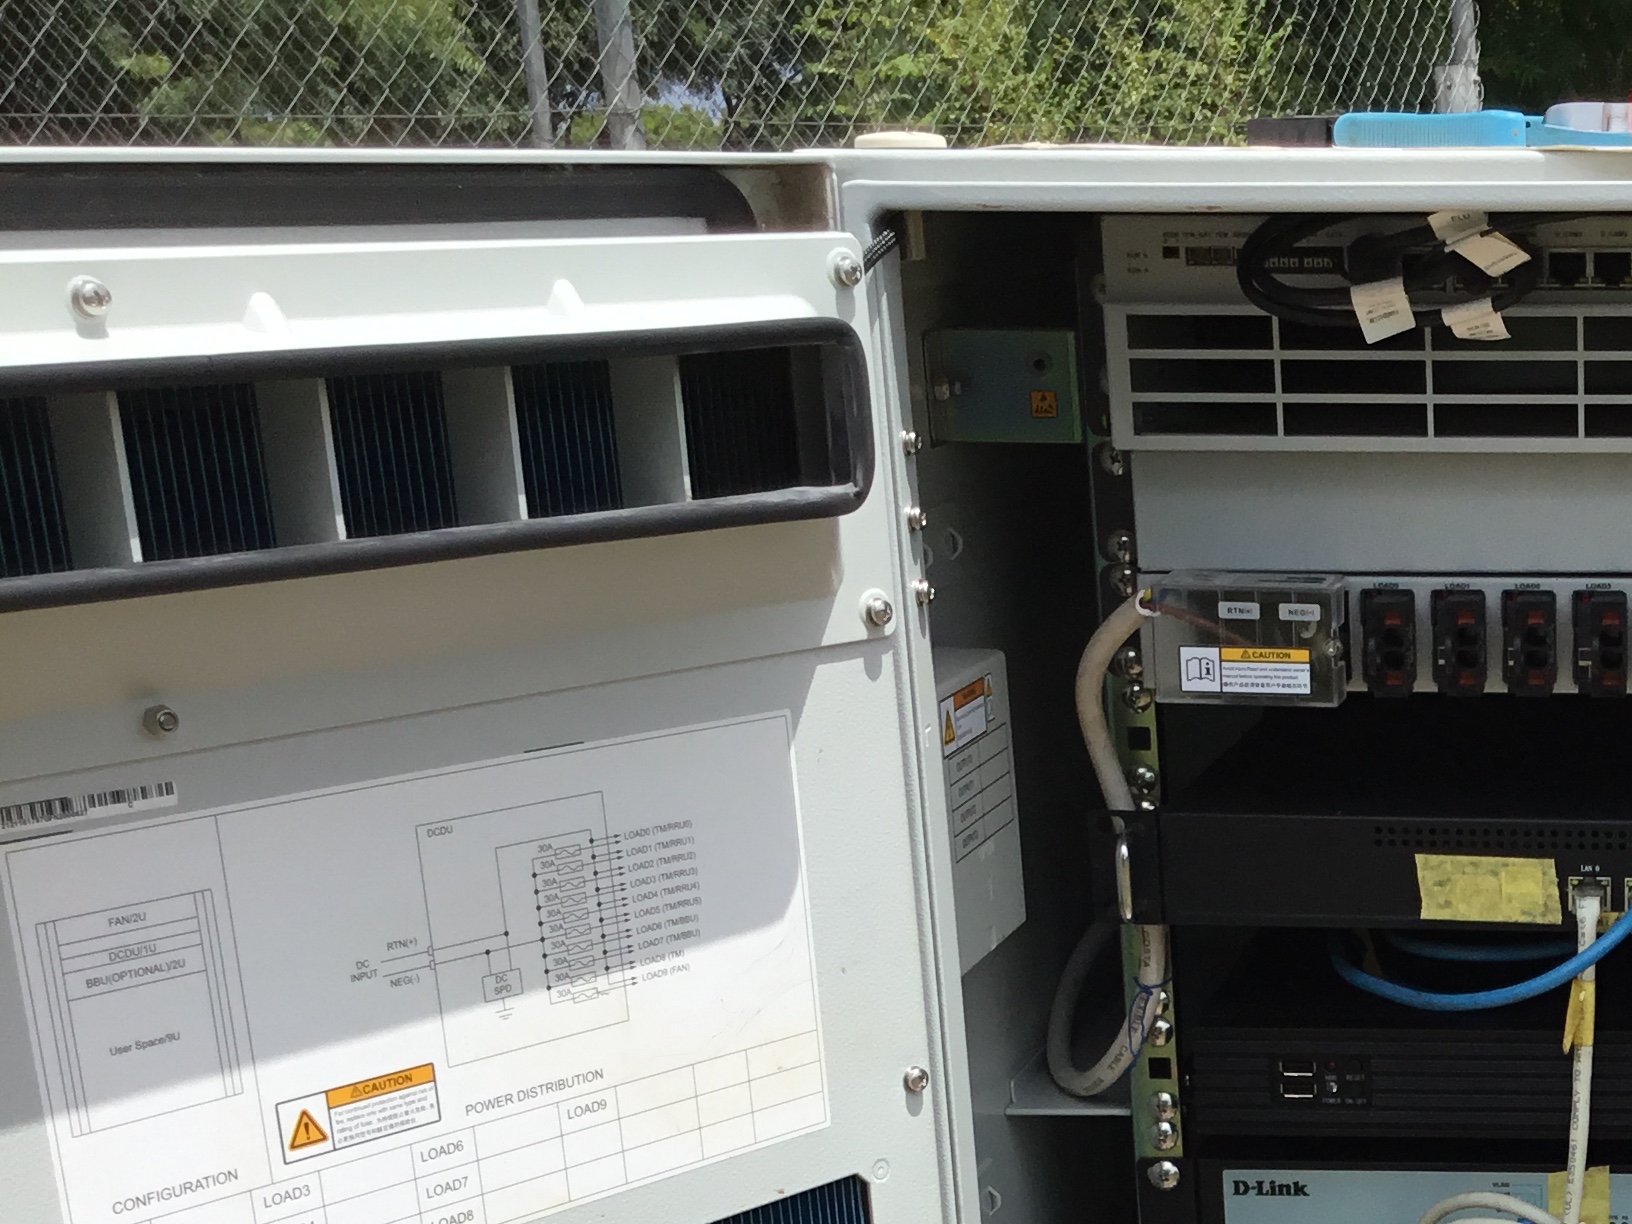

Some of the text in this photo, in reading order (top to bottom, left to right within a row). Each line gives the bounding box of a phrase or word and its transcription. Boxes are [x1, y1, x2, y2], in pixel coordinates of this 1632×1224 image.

[1252, 651, 1291, 660] CAUTION
[426, 826, 454, 838] DCDU
[1580, 864, 1593, 872] LAN
[108, 911, 147, 928] FAN/2U
[108, 943, 157, 962] DCDU/1U
[387, 937, 418, 951] RTN(+)
[86, 958, 187, 989] BBU(OPTIONAL)/2U
[356, 959, 370, 970] DC
[350, 969, 378, 983] INPUT
[390, 974, 420, 988] NEG(-)
[495, 974, 508, 984] DC
[494, 985, 512, 995] SPD
[109, 1031, 181, 1057] User Space/9U
[1106, 1045, 1128, 1072] CABLE
[362, 1074, 413, 1095] CAUTION
[465, 1091, 514, 1117] POWER
[517, 1069, 605, 1103] DISTRIBUTION
[566, 1099, 608, 1120] LOAD9
[420, 1140, 464, 1163] LOAD6
[112, 1168, 239, 1215] CONFIGURATION
[263, 1184, 311, 1209] LOAD3
[425, 1176, 470, 1200] LOAD7
[1232, 1180, 1310, 1196] D-Link
